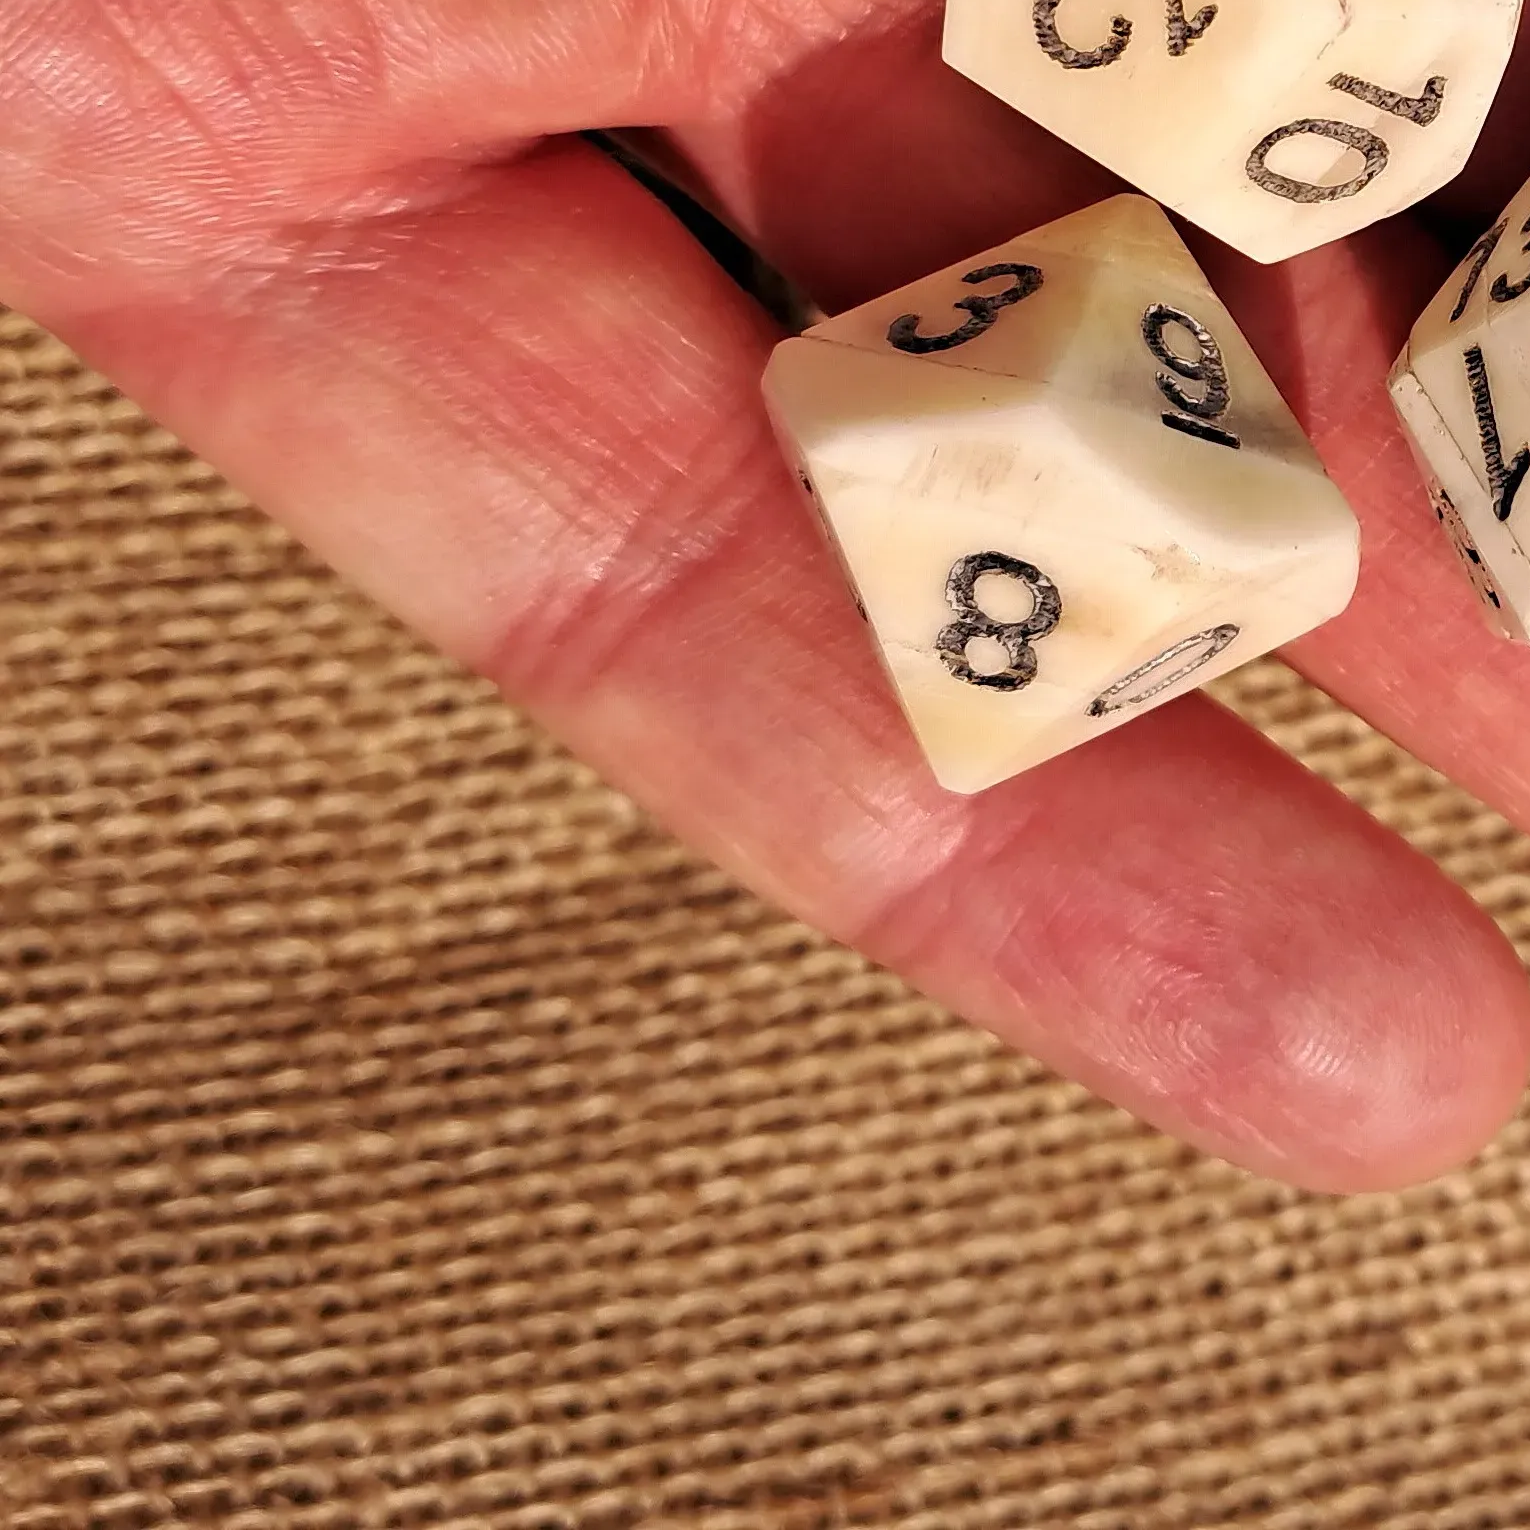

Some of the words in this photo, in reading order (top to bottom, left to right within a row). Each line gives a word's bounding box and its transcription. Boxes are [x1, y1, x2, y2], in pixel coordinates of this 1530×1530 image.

[1245, 74, 1448, 204] 10
[887, 262, 1044, 355] 3
[936, 550, 1063, 692] 8
[1084, 623, 1240, 718] 0
